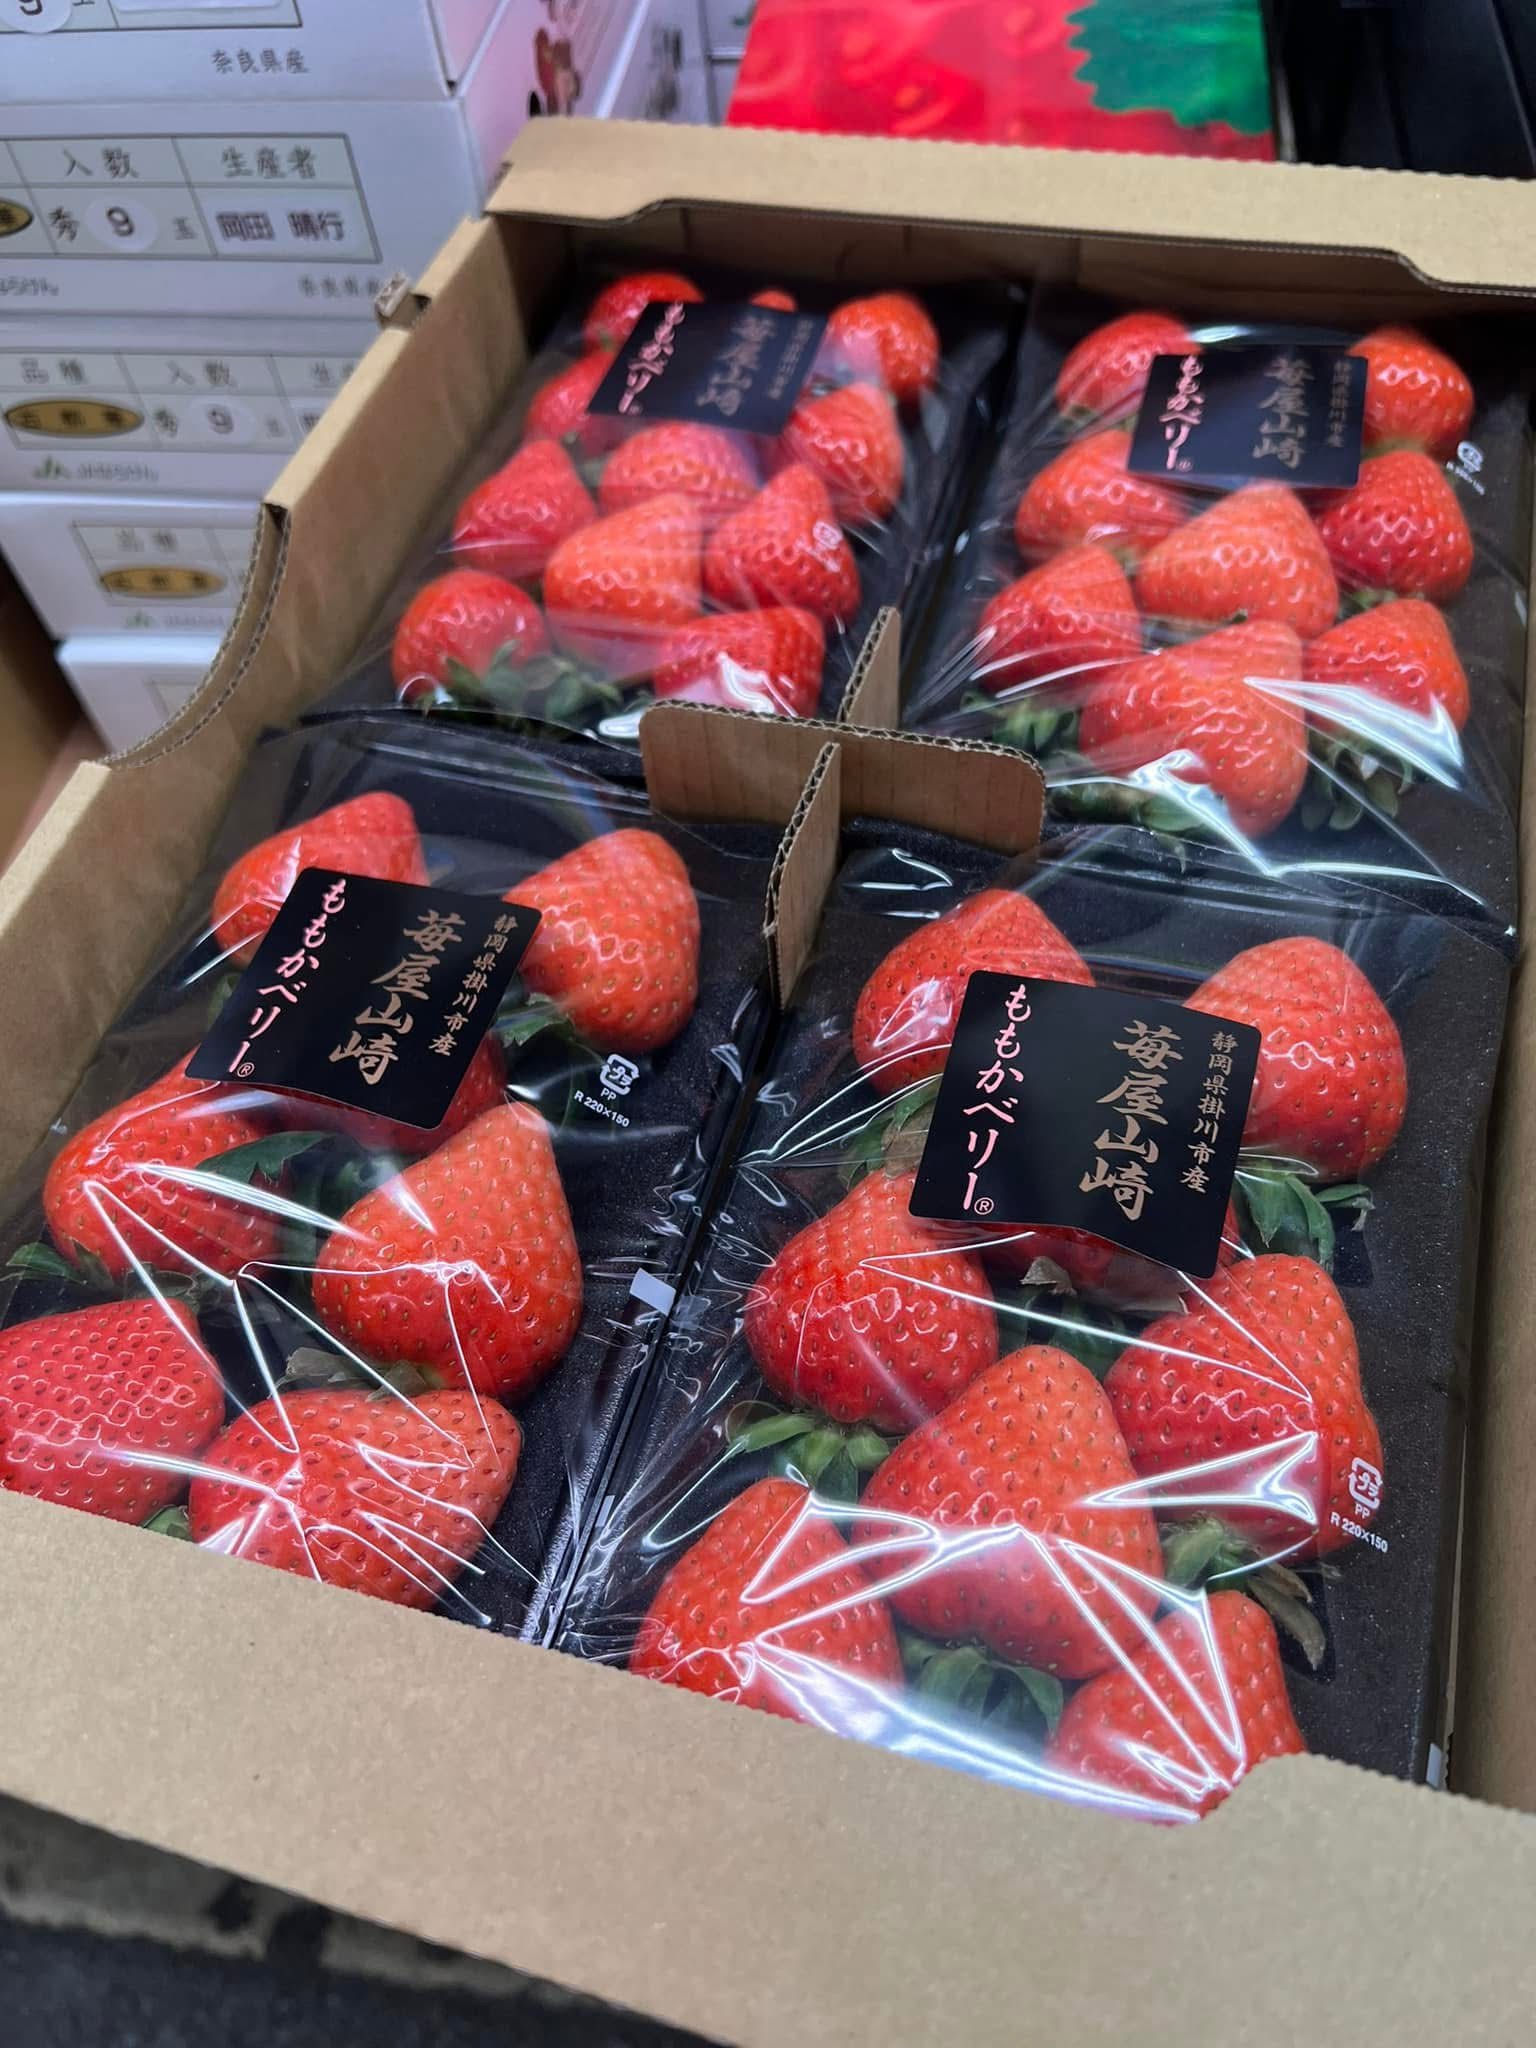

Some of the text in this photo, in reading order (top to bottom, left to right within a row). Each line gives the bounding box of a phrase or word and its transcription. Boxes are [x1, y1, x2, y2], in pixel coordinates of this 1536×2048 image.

[212, 48, 310, 74] 奈良県産
[64, 146, 140, 180] 入数
[220, 146, 319, 181] 生産者
[106, 206, 135, 237] 9
[329, 908, 467, 1086] 苺屋山崎
[428, 913, 518, 1057] 静岡県掛川市産
[573, 1090, 585, 1103] R
[600, 1087, 617, 1101] PP
[1079, 1019, 1184, 1222] 苺屋山崎
[1180, 1030, 1239, 1194] 静岡県掛川市産
[1330, 1511, 1341, 1527] R
[1354, 1503, 1371, 1519] PP
